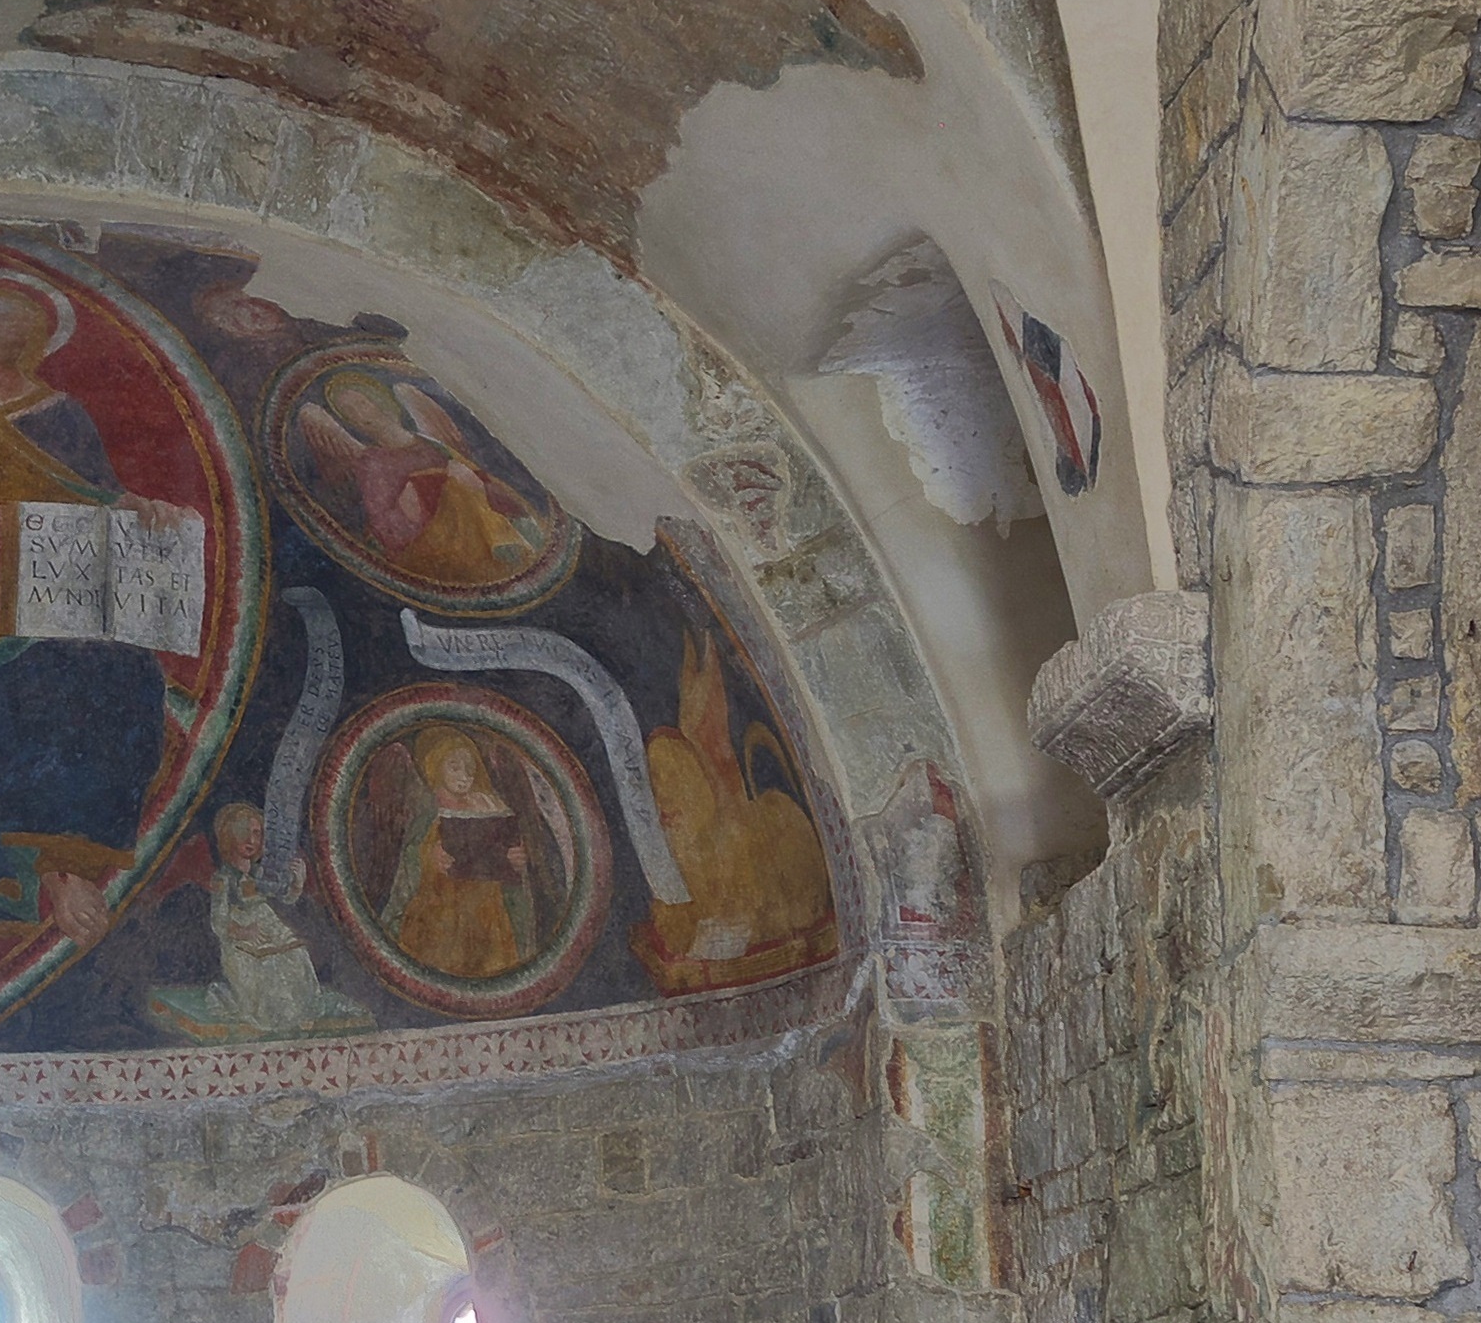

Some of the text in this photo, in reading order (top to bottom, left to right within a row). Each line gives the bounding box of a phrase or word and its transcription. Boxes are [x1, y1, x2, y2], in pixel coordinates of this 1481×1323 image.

[32, 560, 91, 581] LVX
[115, 565, 190, 592] TAS ET
[113, 591, 188, 619] VITA
